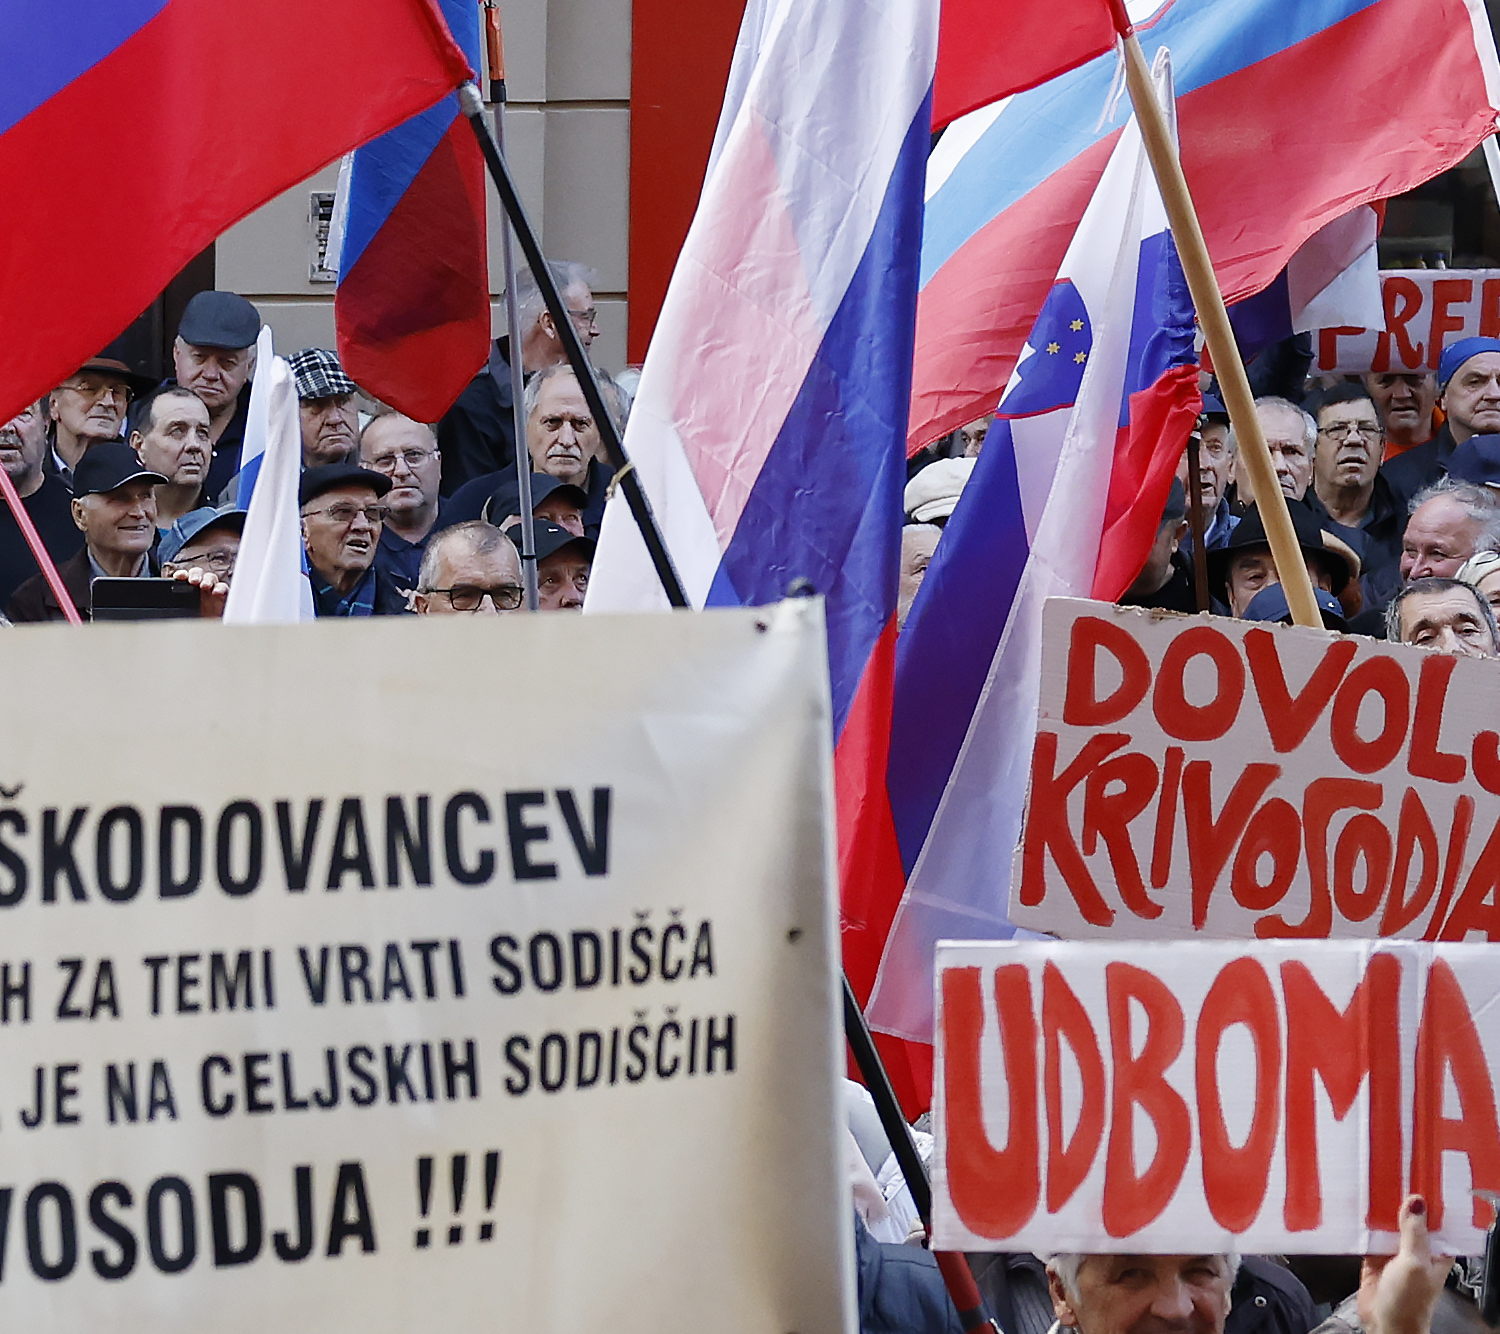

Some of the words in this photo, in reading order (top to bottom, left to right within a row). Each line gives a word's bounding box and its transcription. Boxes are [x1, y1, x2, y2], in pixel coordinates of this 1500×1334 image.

[55, 958, 122, 1022] ZA
[143, 948, 274, 1016] TEMI
[297, 939, 467, 1006] VRATI
[487, 907, 718, 998] SODIŠČA
[19, 1064, 81, 1130] JE
[105, 1060, 178, 1127] NA
[201, 1038, 481, 1120] CELJSKIH
[503, 1006, 738, 1100] SODIŠČIH
[412, 1150, 503, 1251] !!!
